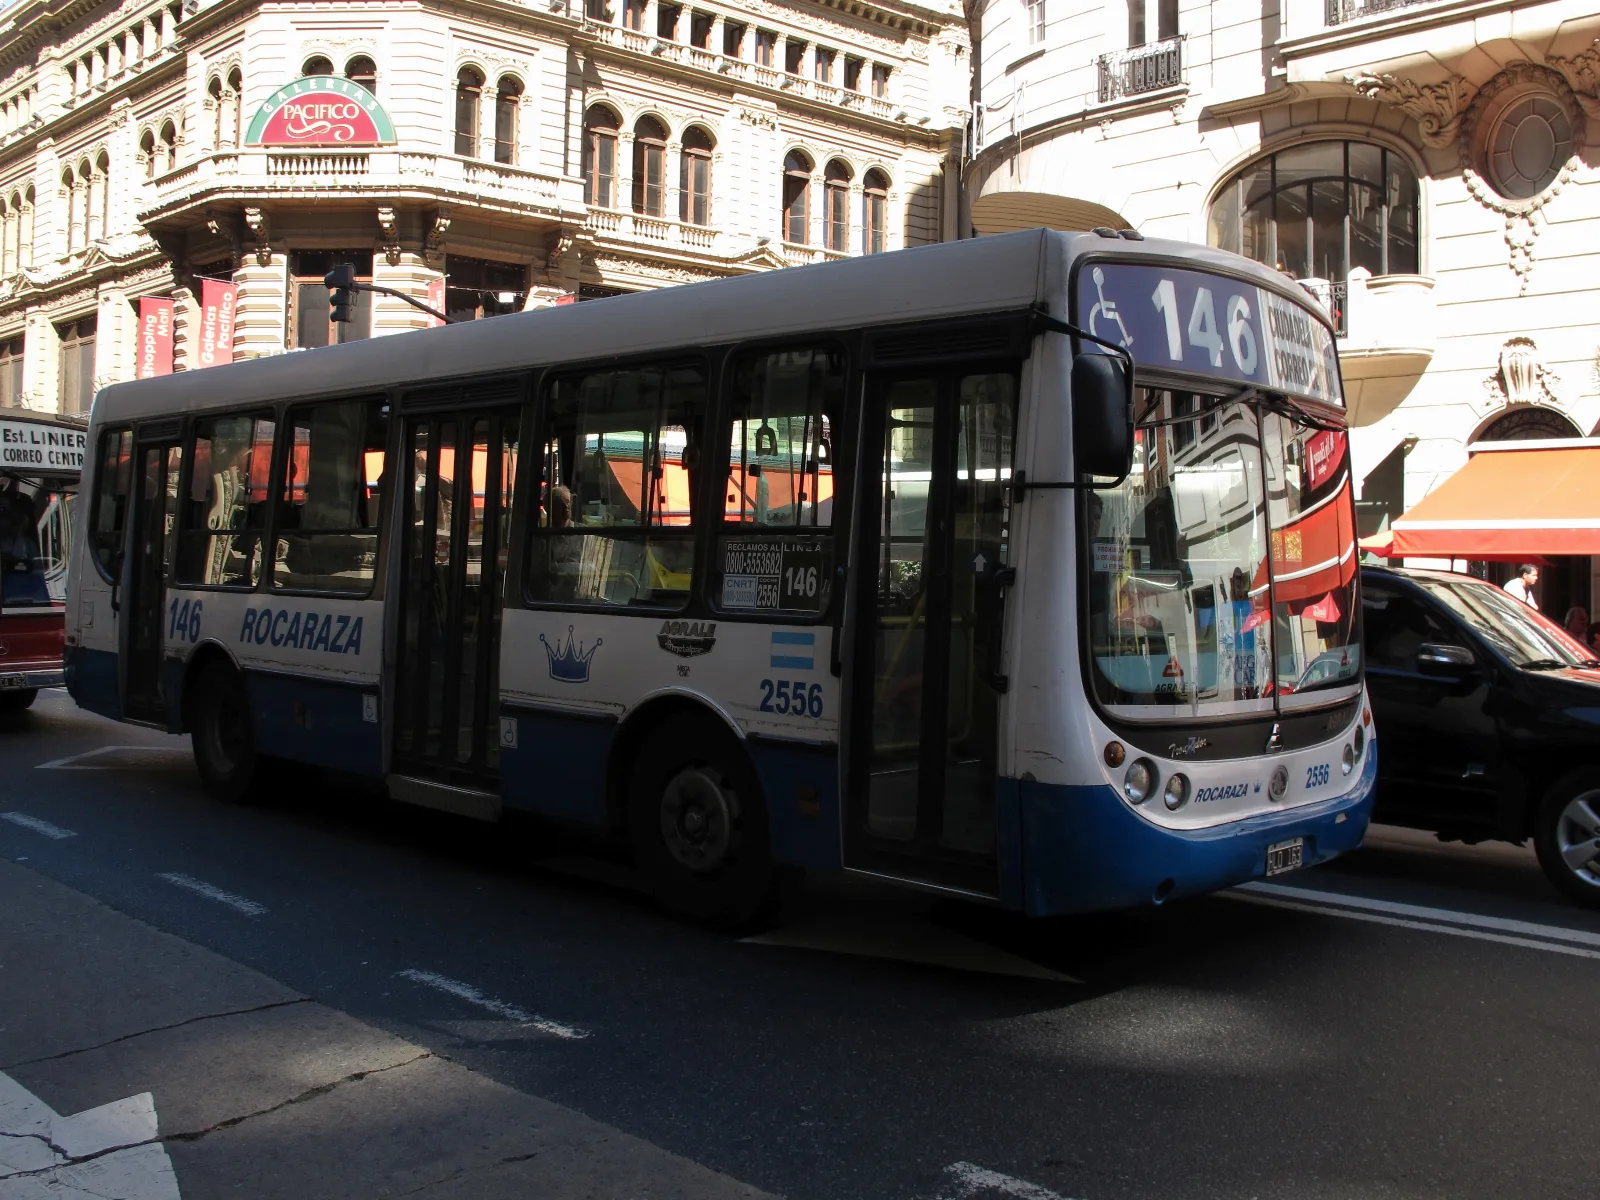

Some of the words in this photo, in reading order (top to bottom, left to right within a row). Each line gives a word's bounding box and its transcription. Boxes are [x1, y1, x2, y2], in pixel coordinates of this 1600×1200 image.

[262, 77, 378, 113] GALERIAS
[284, 103, 360, 120] PACIFICO
[157, 308, 169, 337] Mall
[202, 306, 217, 364] Galerías
[1151, 279, 1258, 376] 146
[1275, 348, 1309, 387] CORREO
[3, 428, 27, 444] Est.
[31, 430, 86, 449] LINIER
[3, 448, 43, 464] CORREO
[48, 450, 84, 467] CENTR
[727, 543, 768, 552] RECLAMOS
[769, 544, 780, 552] AL
[725, 551, 781, 574] 0800-5553682
[726, 579, 755, 589] CNRT
[785, 566, 818, 598] 146
[757, 584, 778, 608] 2556
[169, 597, 203, 644] 146
[240, 607, 364, 656] ROCARAZA
[759, 678, 824, 719] 2556
[1305, 764, 1331, 789] 2556
[1194, 783, 1249, 803] ROCARAZA
